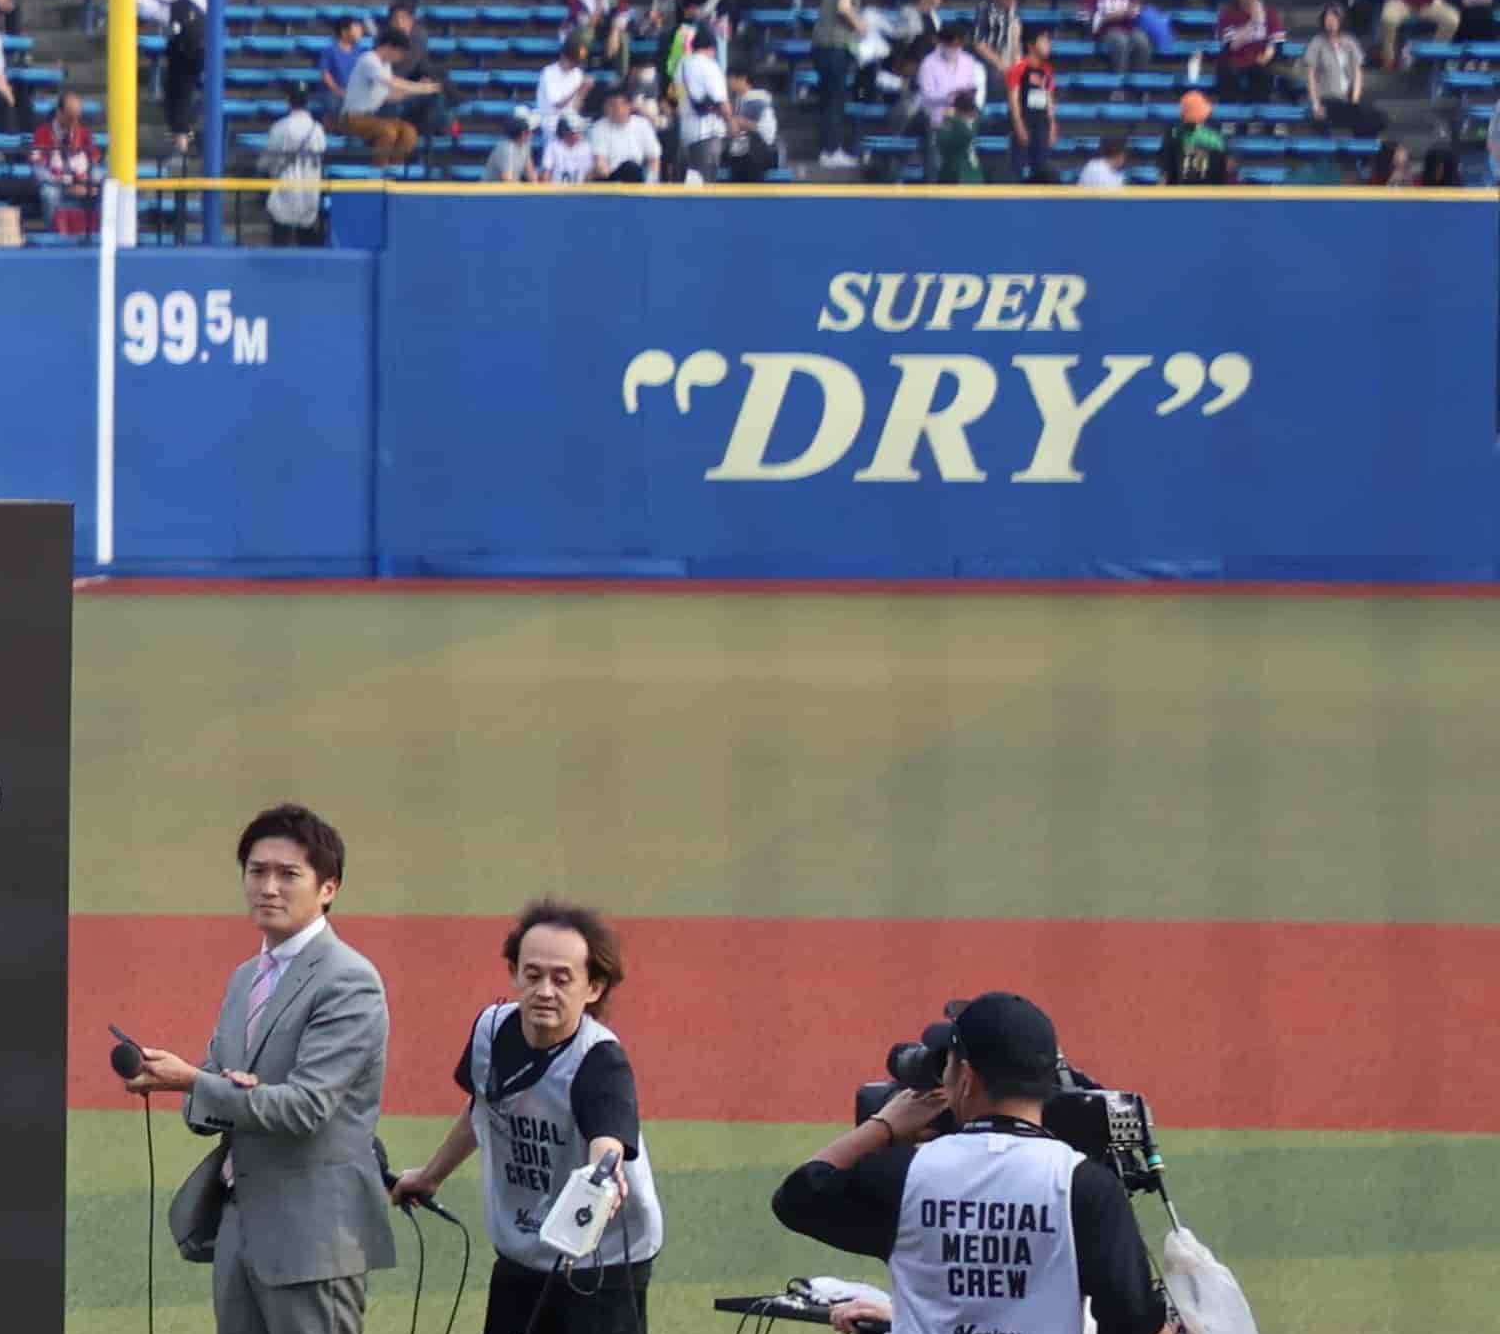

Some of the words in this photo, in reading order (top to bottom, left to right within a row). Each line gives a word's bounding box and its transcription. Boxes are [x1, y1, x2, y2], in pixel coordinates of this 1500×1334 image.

[817, 271, 1088, 333] SUPER
[510, 1113, 566, 1146] ICIAL
[920, 1199, 1056, 1232] OFFICIAL
[941, 1234, 1032, 1266] MEDIA
[947, 1266, 1027, 1300] CREW
